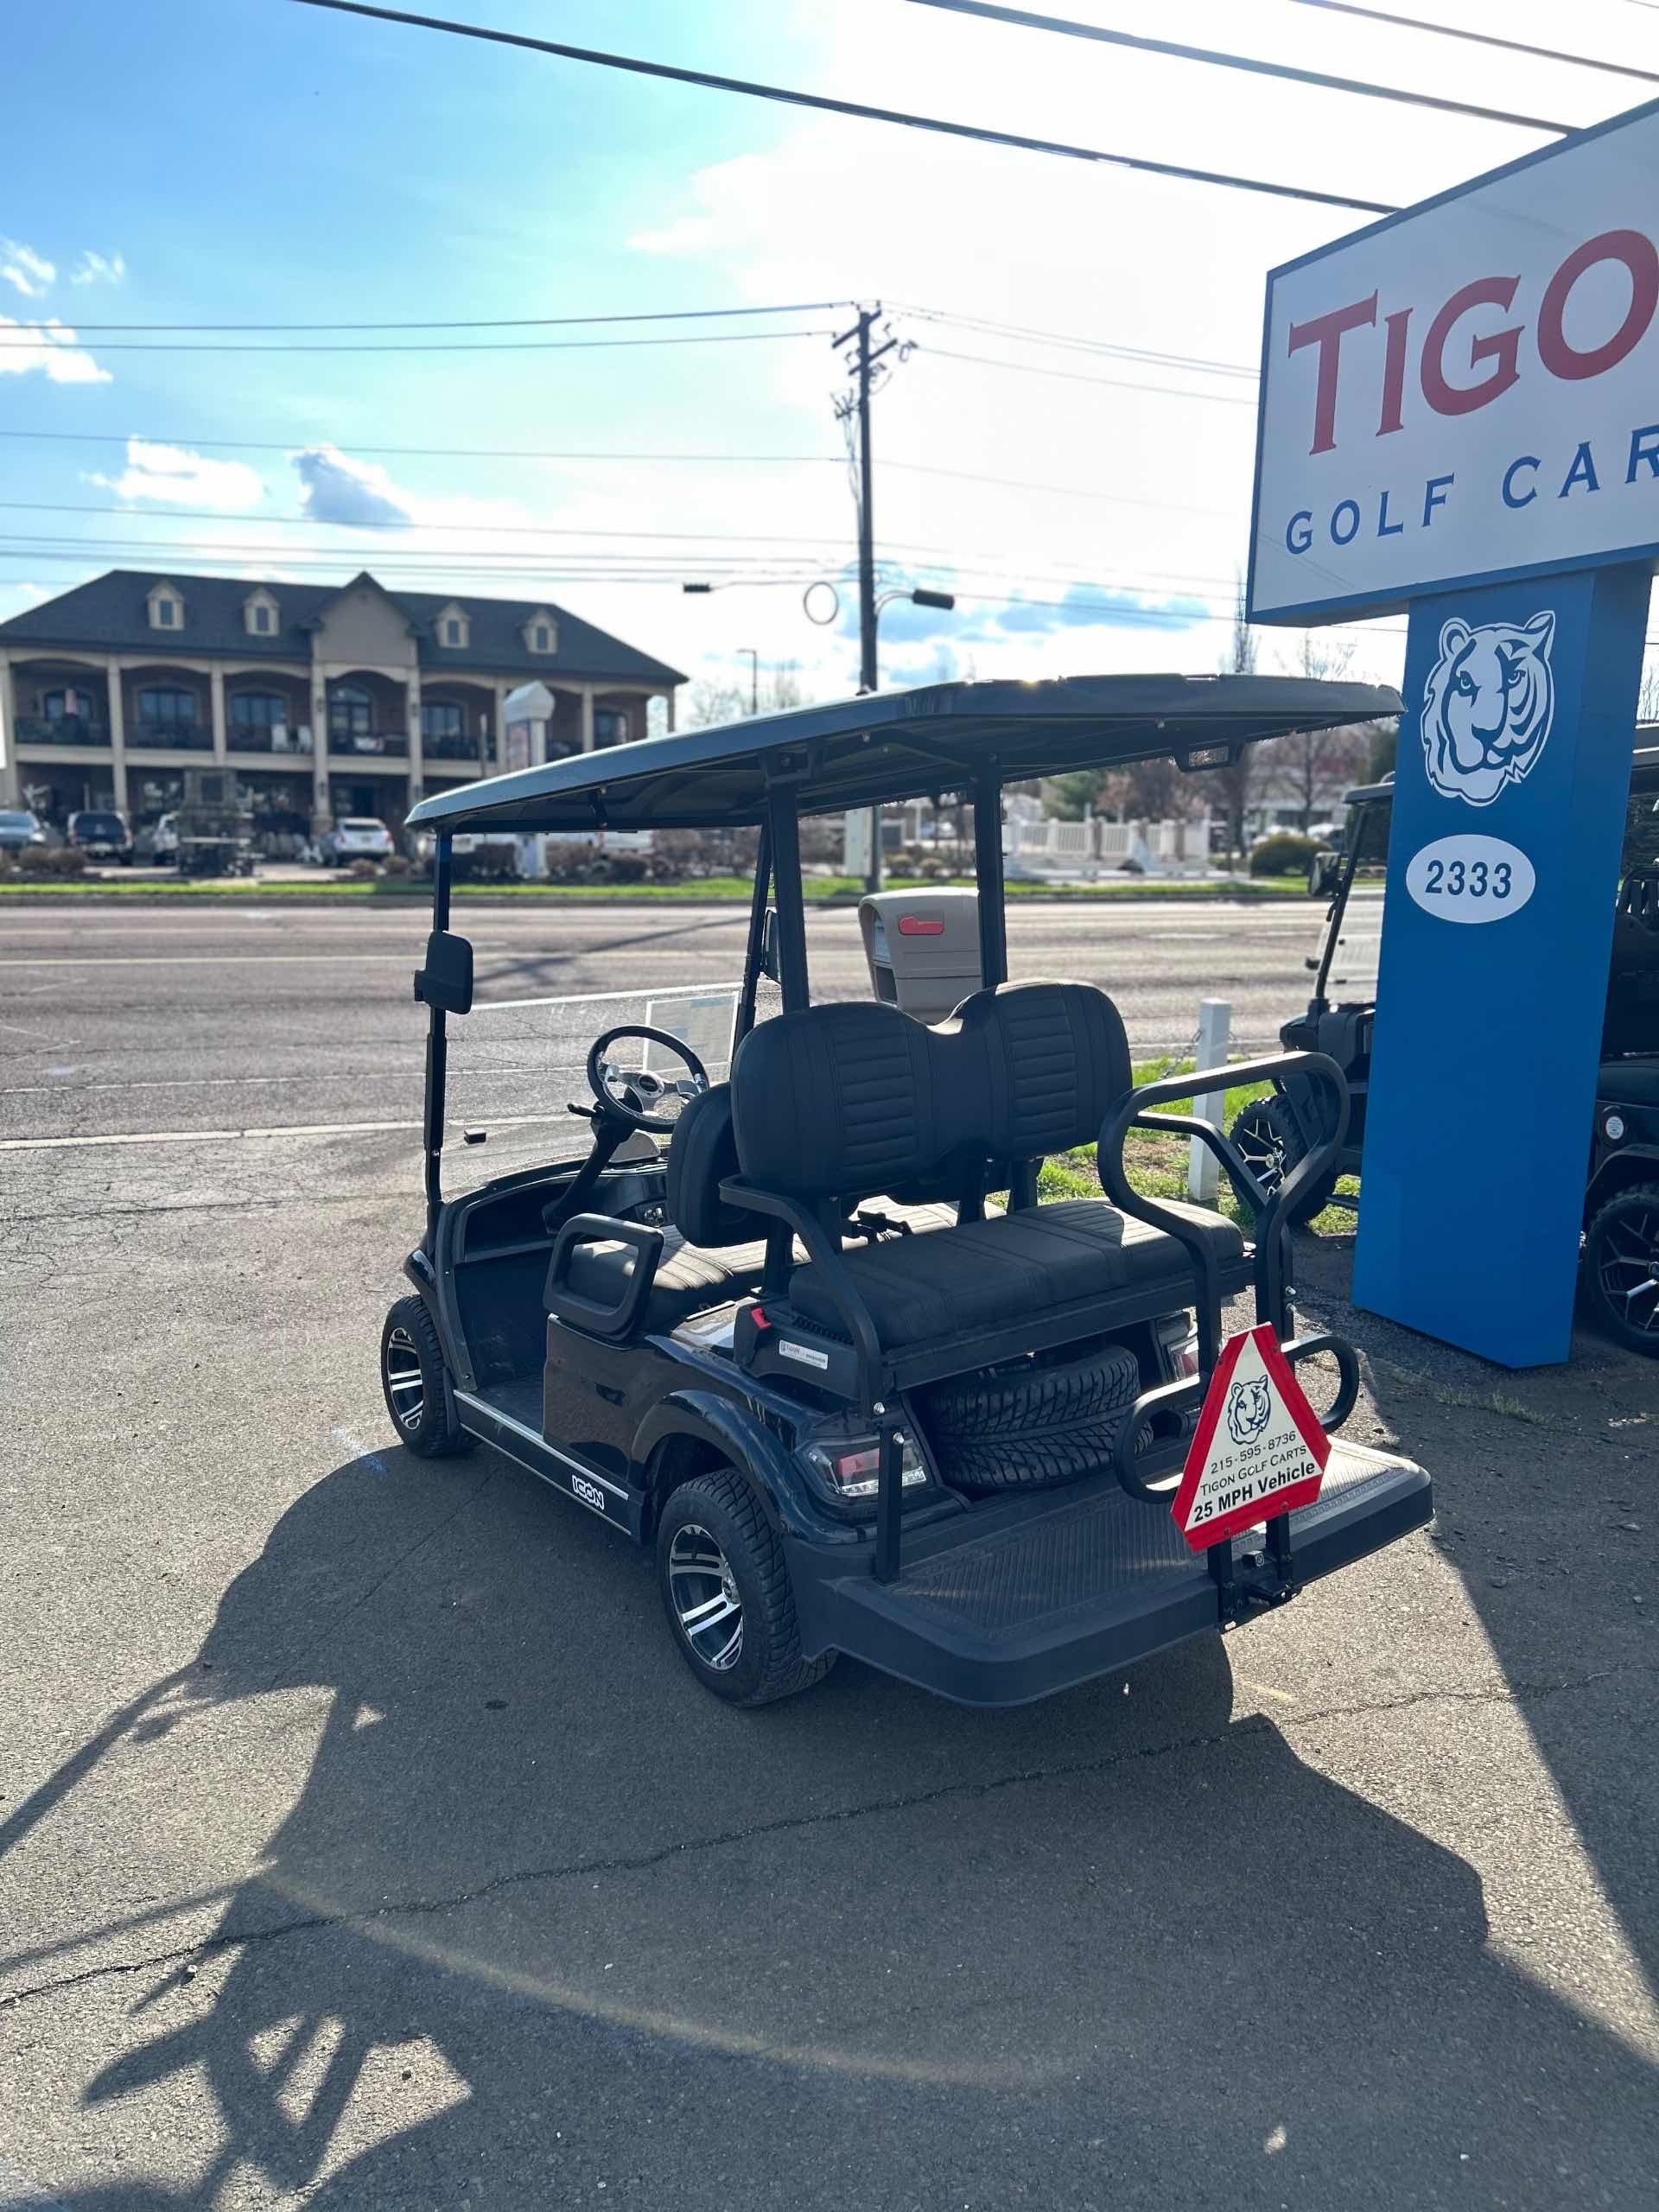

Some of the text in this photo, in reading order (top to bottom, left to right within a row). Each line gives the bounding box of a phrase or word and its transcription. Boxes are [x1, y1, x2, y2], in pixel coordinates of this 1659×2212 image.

[1286, 473, 1454, 555] GOLF
[1425, 860, 1512, 899] 2333
[572, 1475, 605, 1510] ICON
[1194, 1462, 1315, 1522] 25 MPH Vehicle
[1200, 1445, 1306, 1496] TIGON GOLF CARTS
